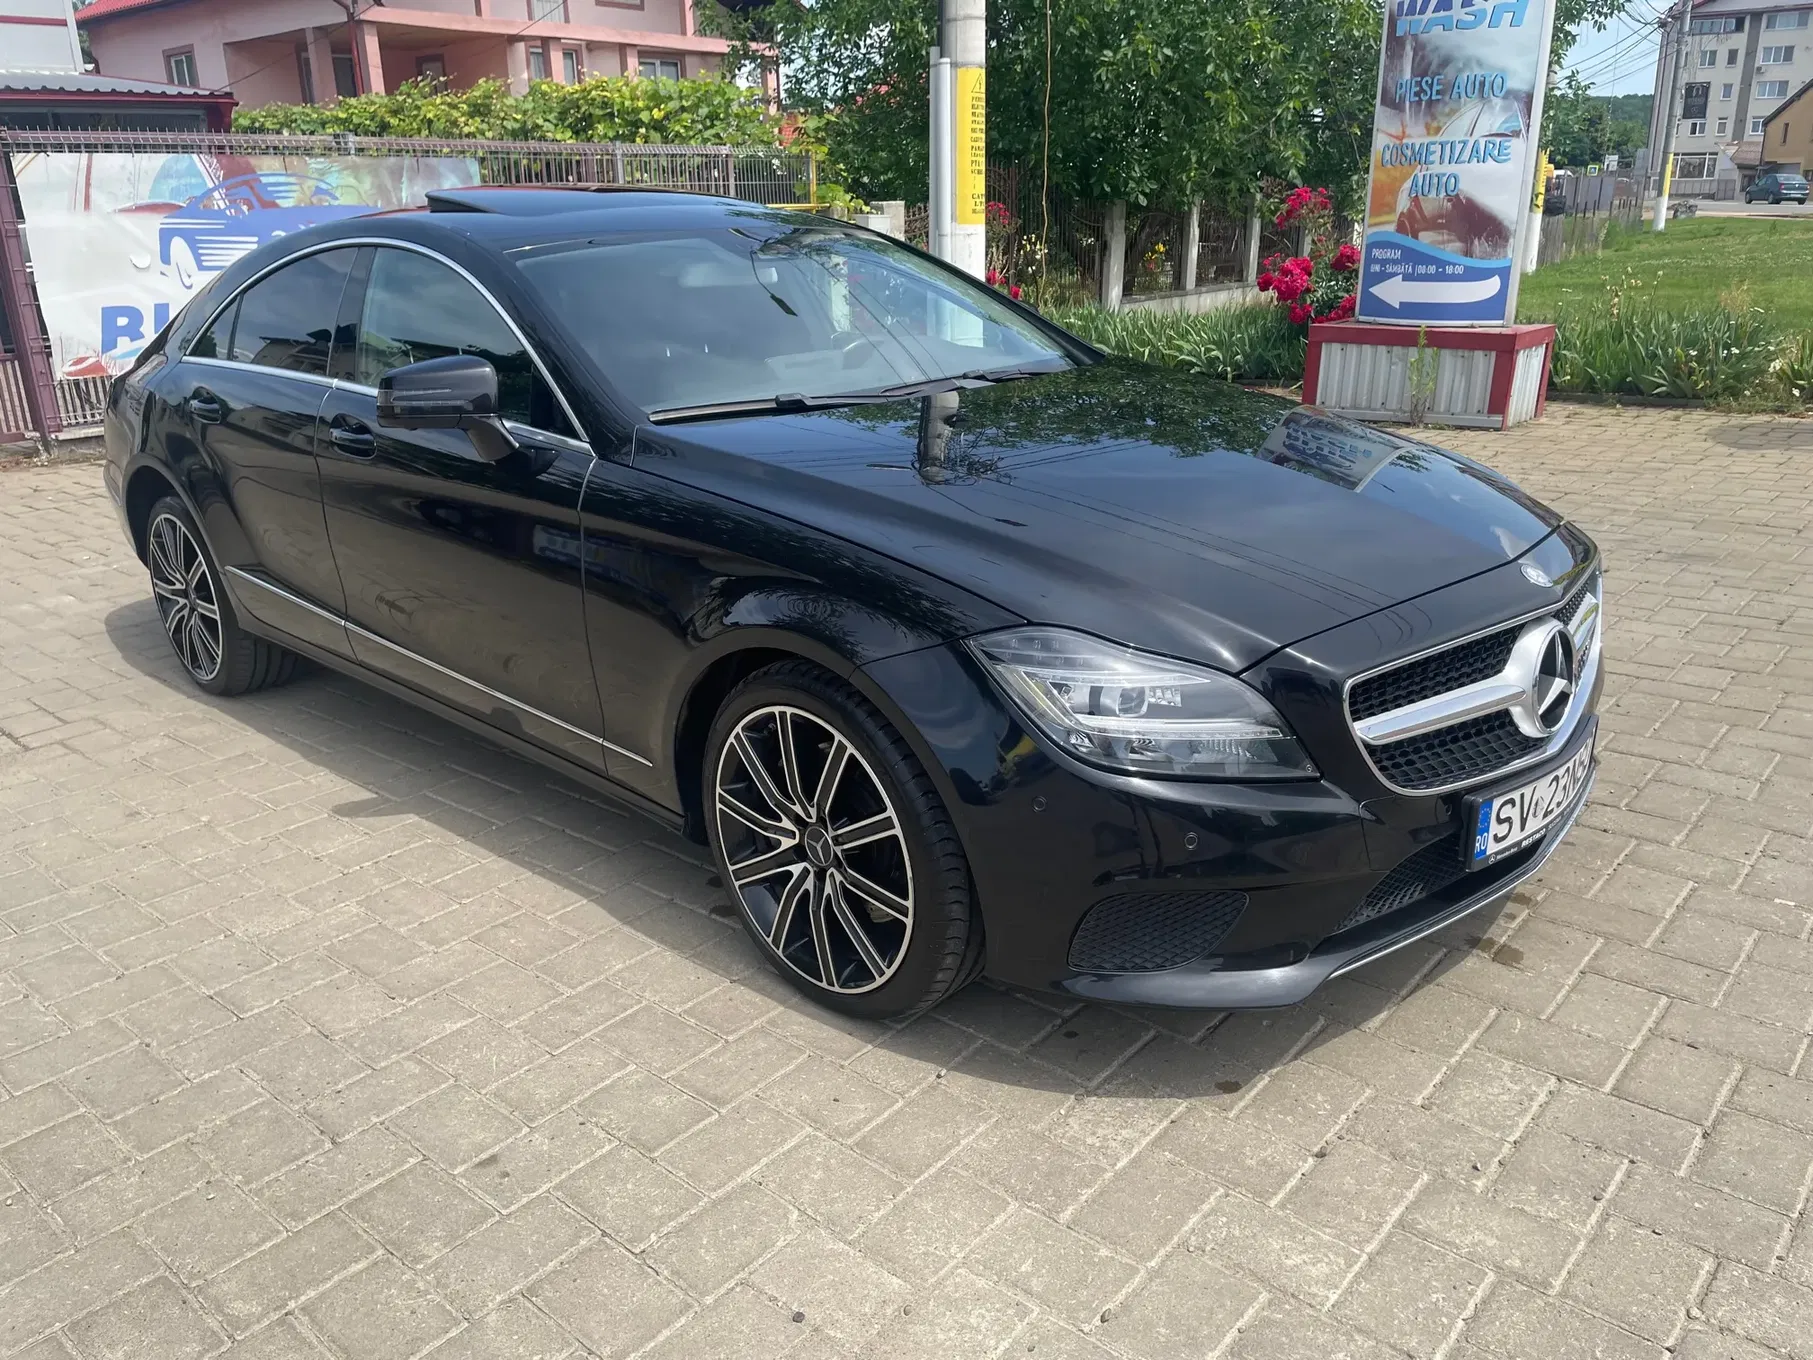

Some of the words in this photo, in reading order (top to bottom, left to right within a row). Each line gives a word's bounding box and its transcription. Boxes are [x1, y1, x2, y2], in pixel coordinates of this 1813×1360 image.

[1395, 75, 1444, 103] PIESE
[1449, 71, 1508, 100] AUTO
[1381, 138, 1513, 168] COSMETIZARE
[1408, 172, 1461, 198] AUTO
[1371, 248, 1401, 260] PROGRAM
[1445, 264, 1464, 275] 18:00
[1492, 785, 1538, 844] SV
[1474, 832, 1488, 853] RO
